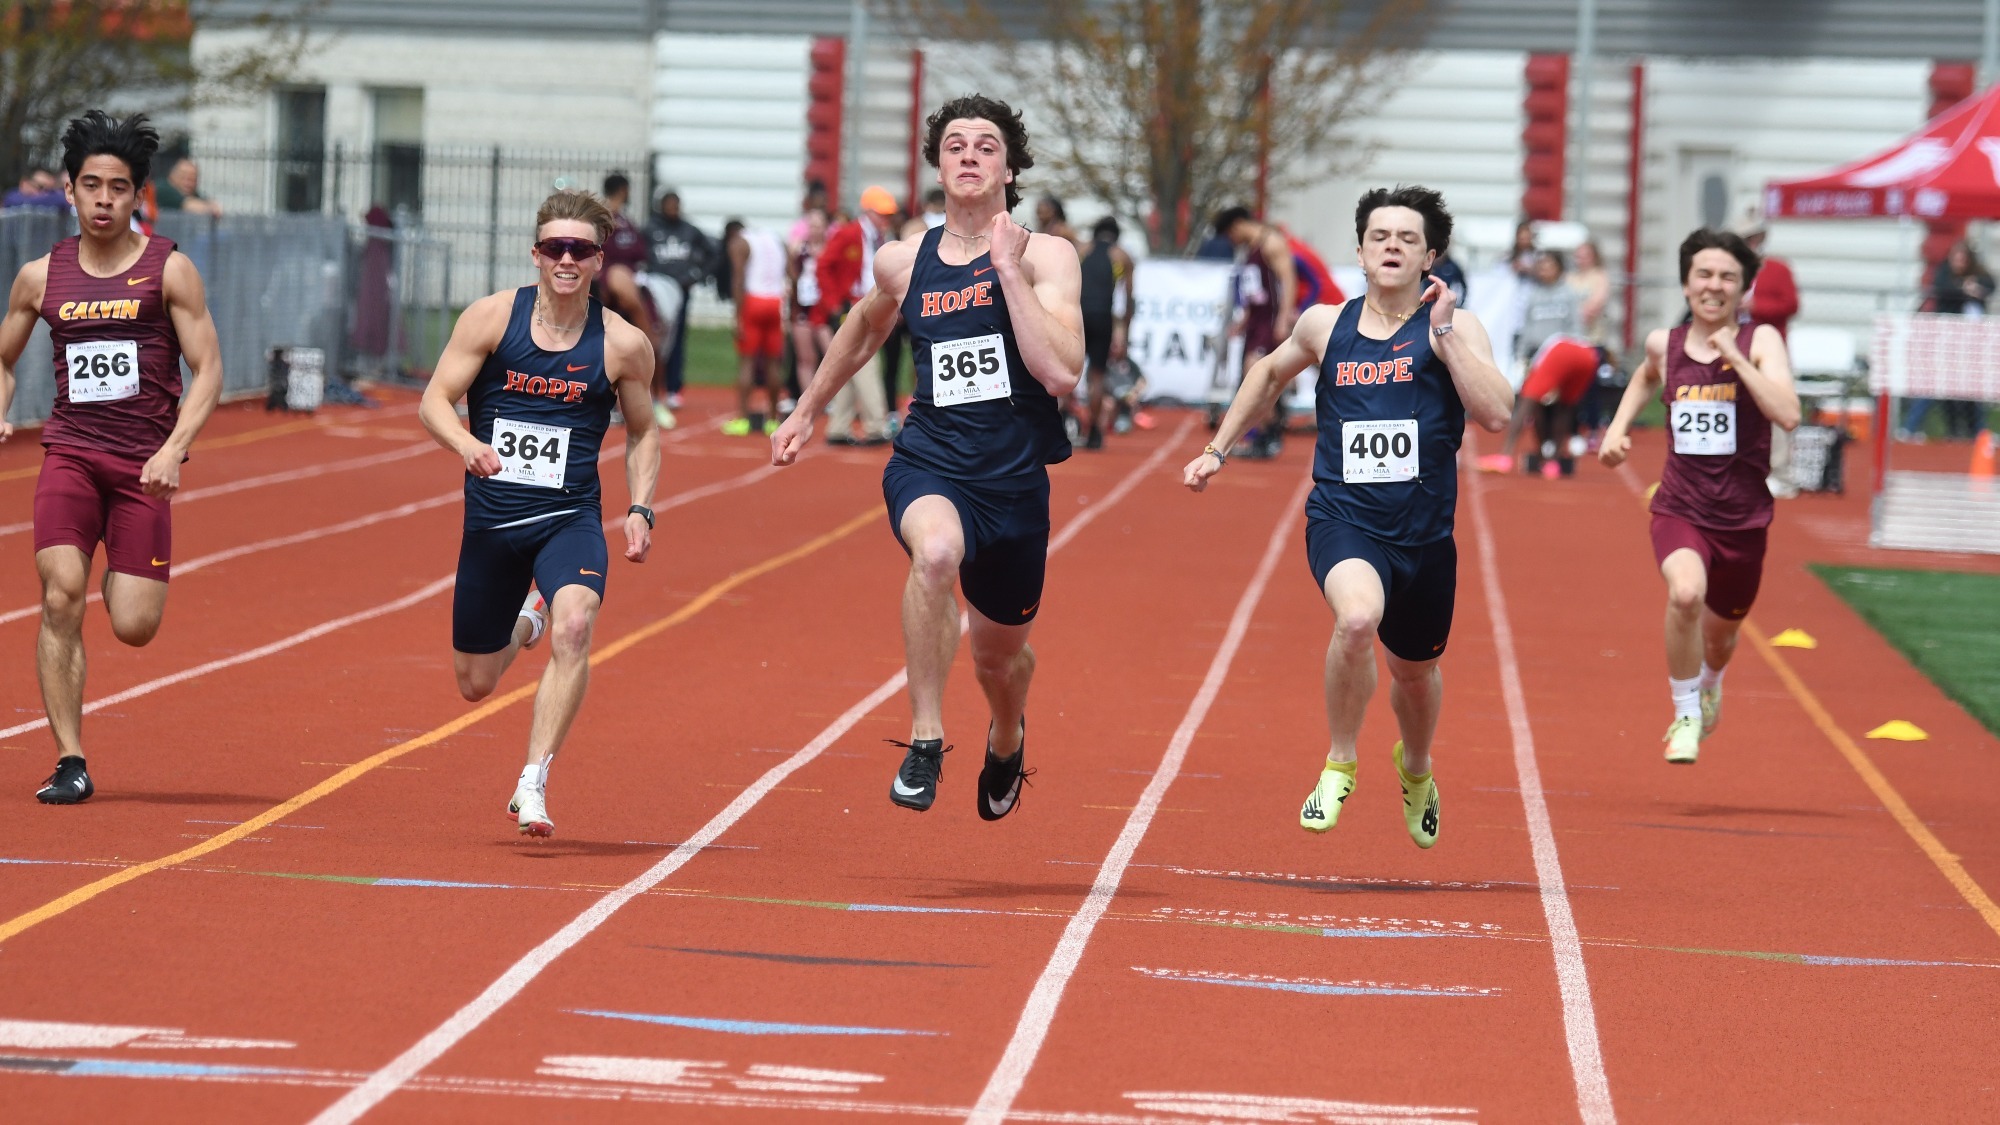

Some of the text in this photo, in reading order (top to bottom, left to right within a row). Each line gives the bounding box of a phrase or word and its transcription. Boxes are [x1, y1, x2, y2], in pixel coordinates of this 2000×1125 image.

[58, 299, 141, 321] CALVIN
[921, 281, 993, 317] HOPE
[73, 352, 131, 379] 266
[938, 347, 1000, 381] 365
[1335, 357, 1413, 387] HOPE
[503, 369, 587, 403] HOPE
[963, 386, 980, 394] MIAA
[1678, 412, 1729, 434] 258
[497, 431, 561, 464] 364
[1349, 432, 1412, 459] 400
[518, 469, 536, 477] MIAA
